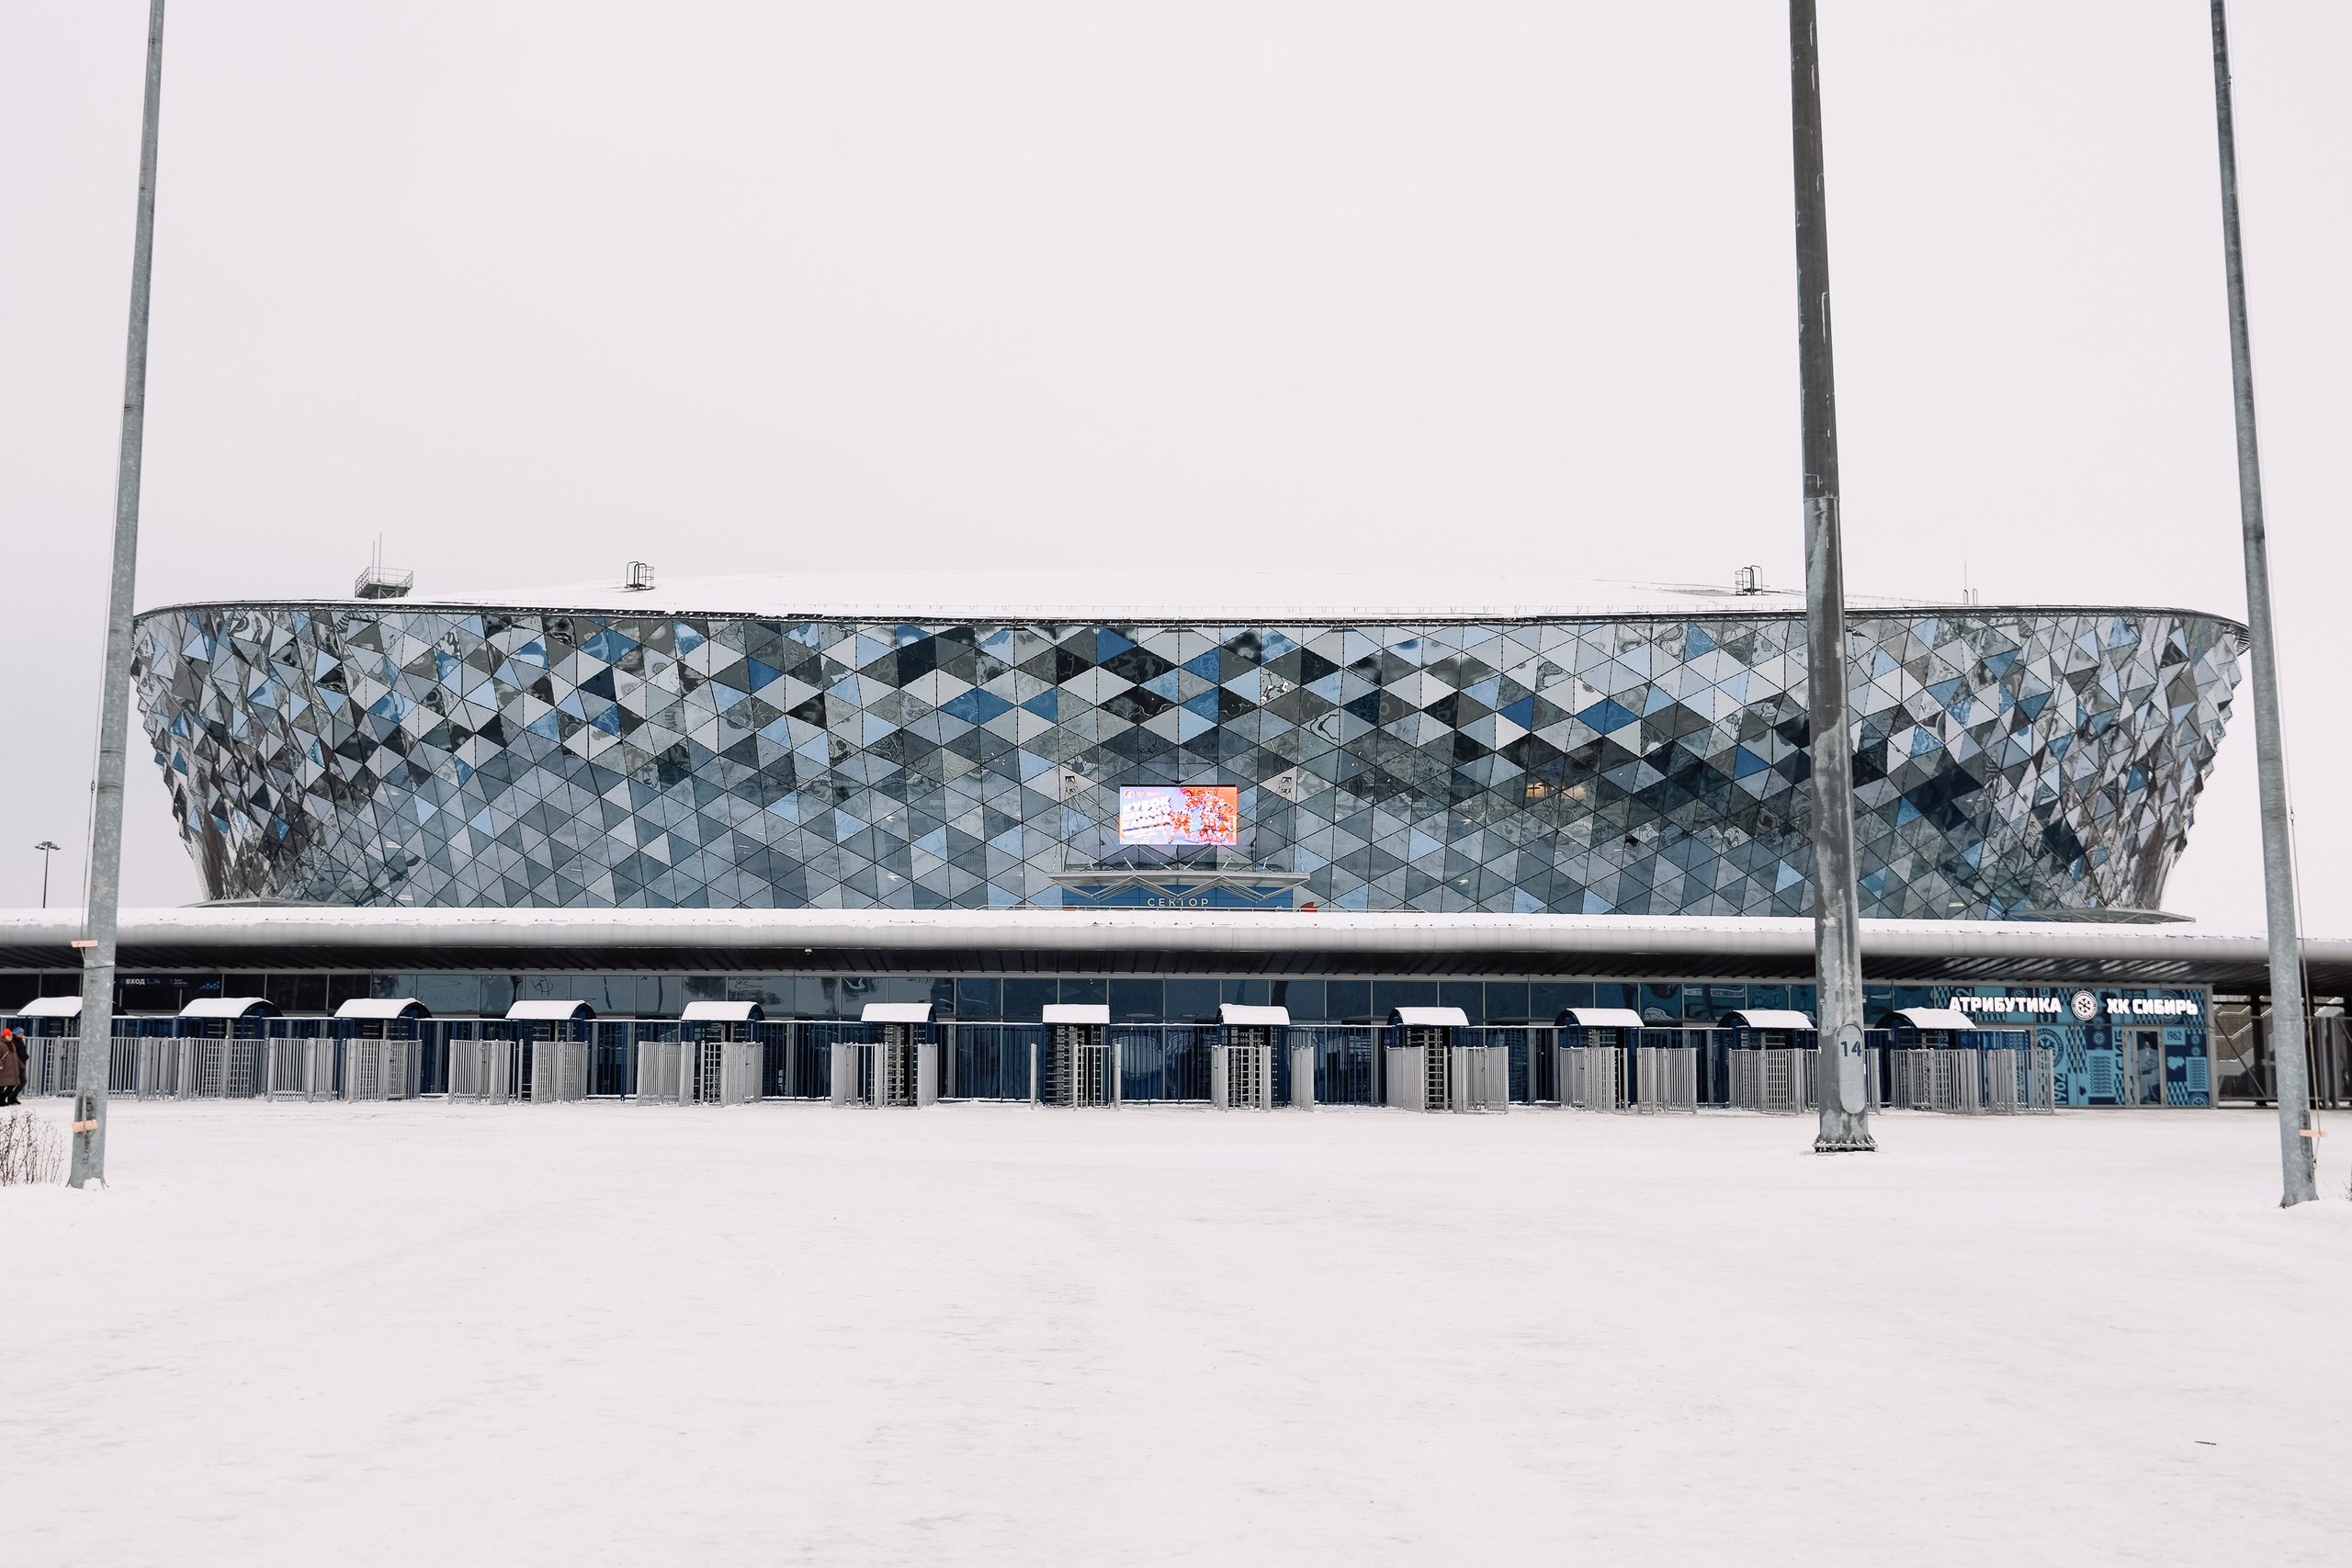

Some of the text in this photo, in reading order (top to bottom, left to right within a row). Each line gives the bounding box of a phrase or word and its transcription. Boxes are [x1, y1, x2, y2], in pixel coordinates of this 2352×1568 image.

[1147, 897, 1209, 907] СЕКТОР
[1949, 997, 2063, 1013] АТРИБУТИКА
[2106, 998, 2131, 1014] ХК
[2132, 998, 2199, 1015] СИБИРЬ
[2166, 1031, 2181, 1041] 1962
[1840, 1041, 1862, 1057] 14
